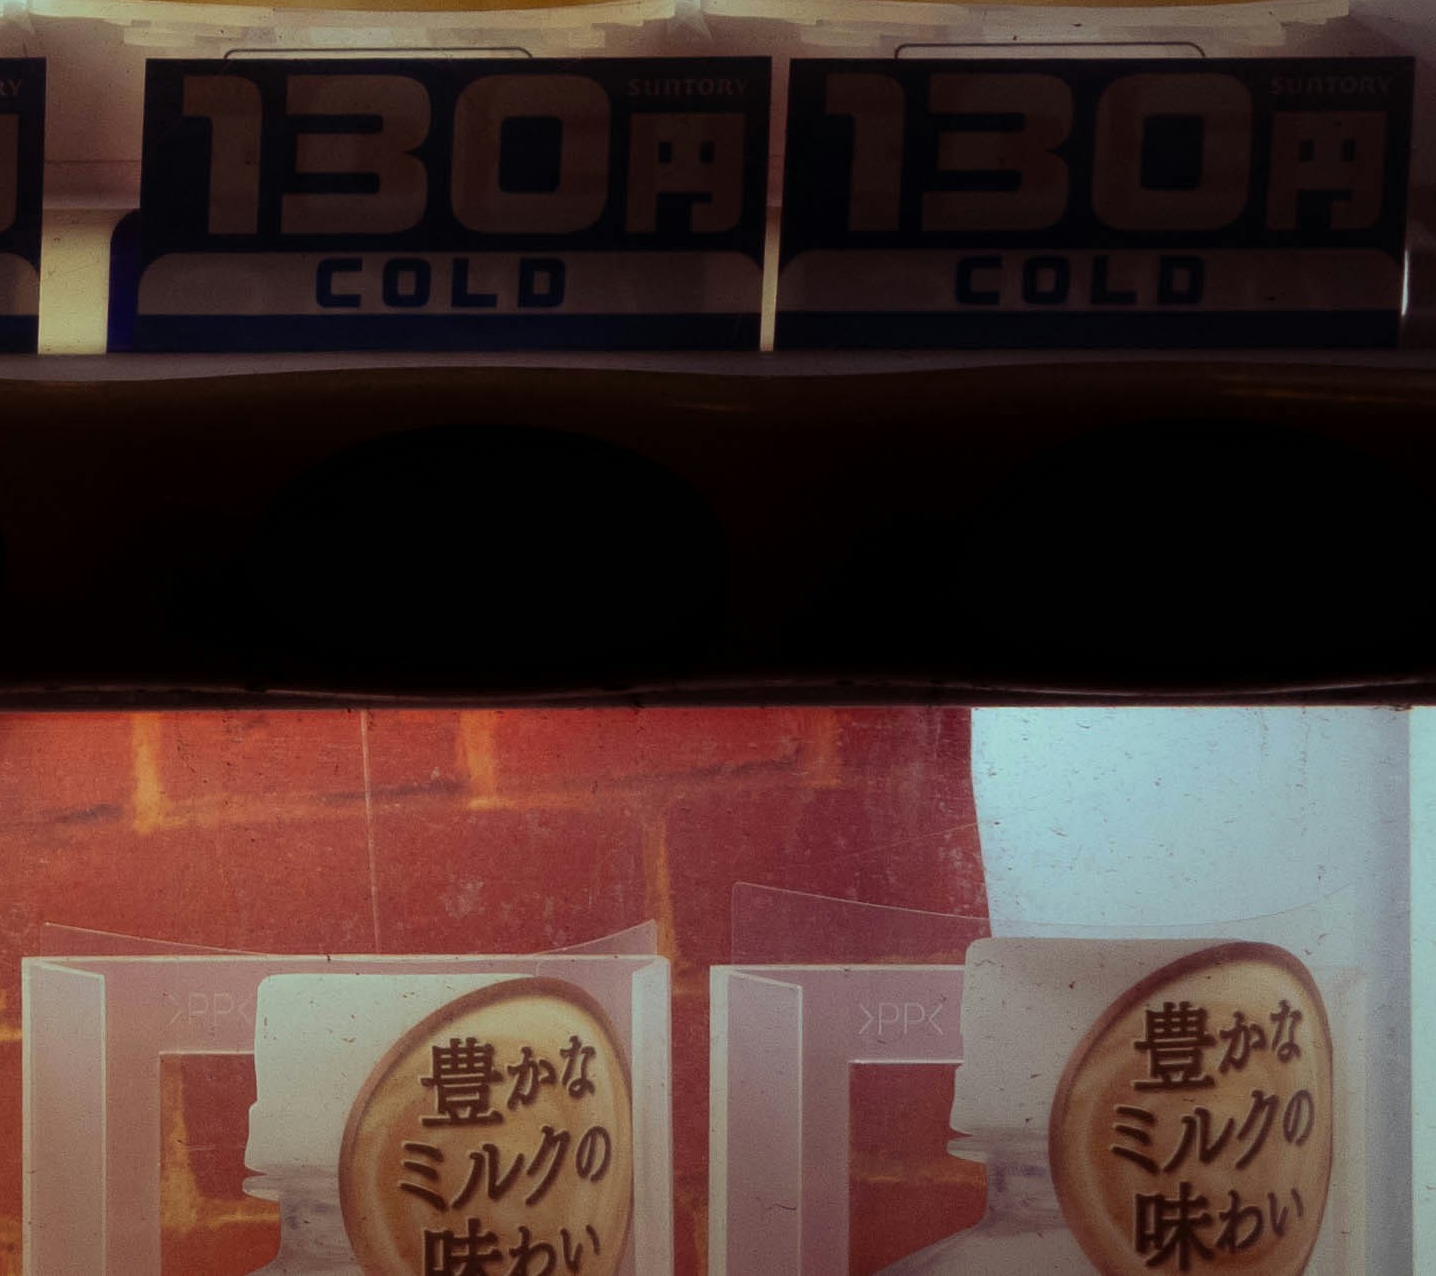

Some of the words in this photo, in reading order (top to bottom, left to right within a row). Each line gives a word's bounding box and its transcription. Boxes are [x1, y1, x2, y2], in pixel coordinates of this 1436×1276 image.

[315, 257, 566, 310] COLD
[956, 254, 1204, 307] COLD
[419, 1035, 596, 1130] 豊かな
[1134, 1000, 1302, 1092] 豊かな
[399, 1125, 611, 1212] ミルクの
[1112, 1087, 1313, 1175] ミルクの
[1134, 1181, 1305, 1273] 味わい
